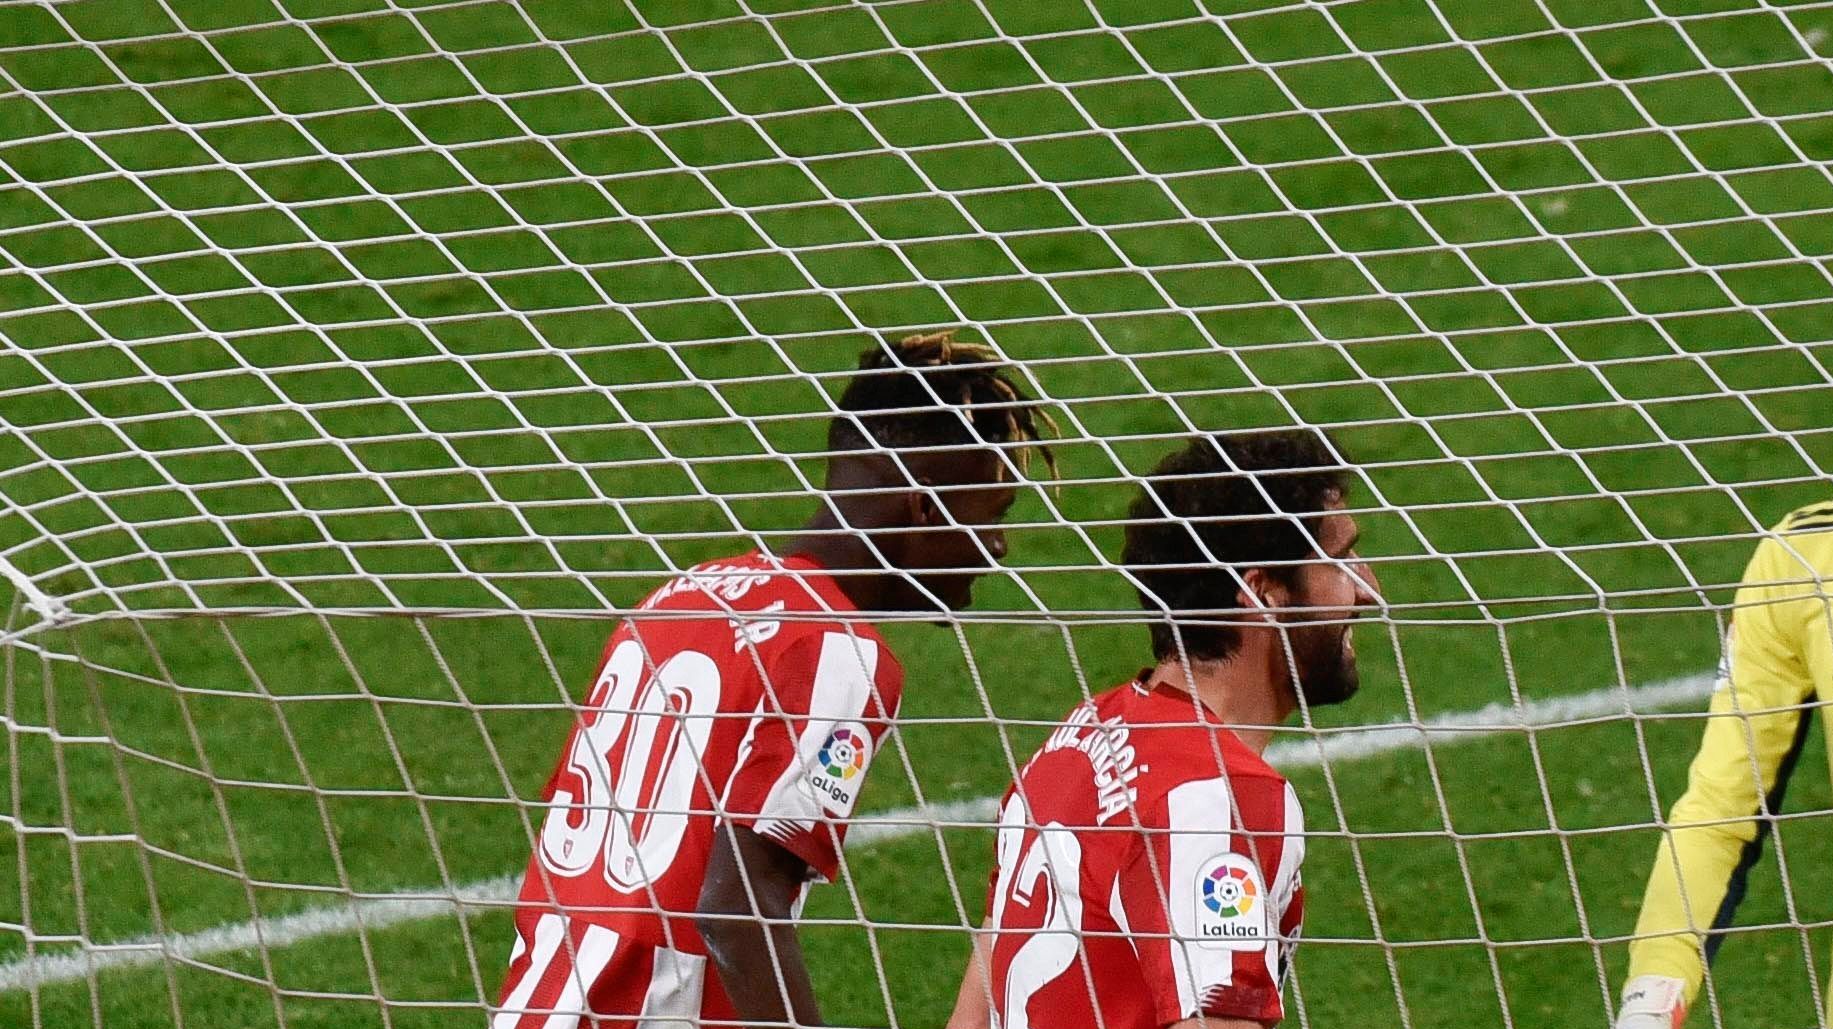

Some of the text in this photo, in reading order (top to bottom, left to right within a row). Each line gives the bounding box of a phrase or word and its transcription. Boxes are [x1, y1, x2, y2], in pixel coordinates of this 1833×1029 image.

[539, 640, 722, 895] 30
[808, 769, 850, 805] aLiga
[1203, 921, 1259, 938] LaLiga
